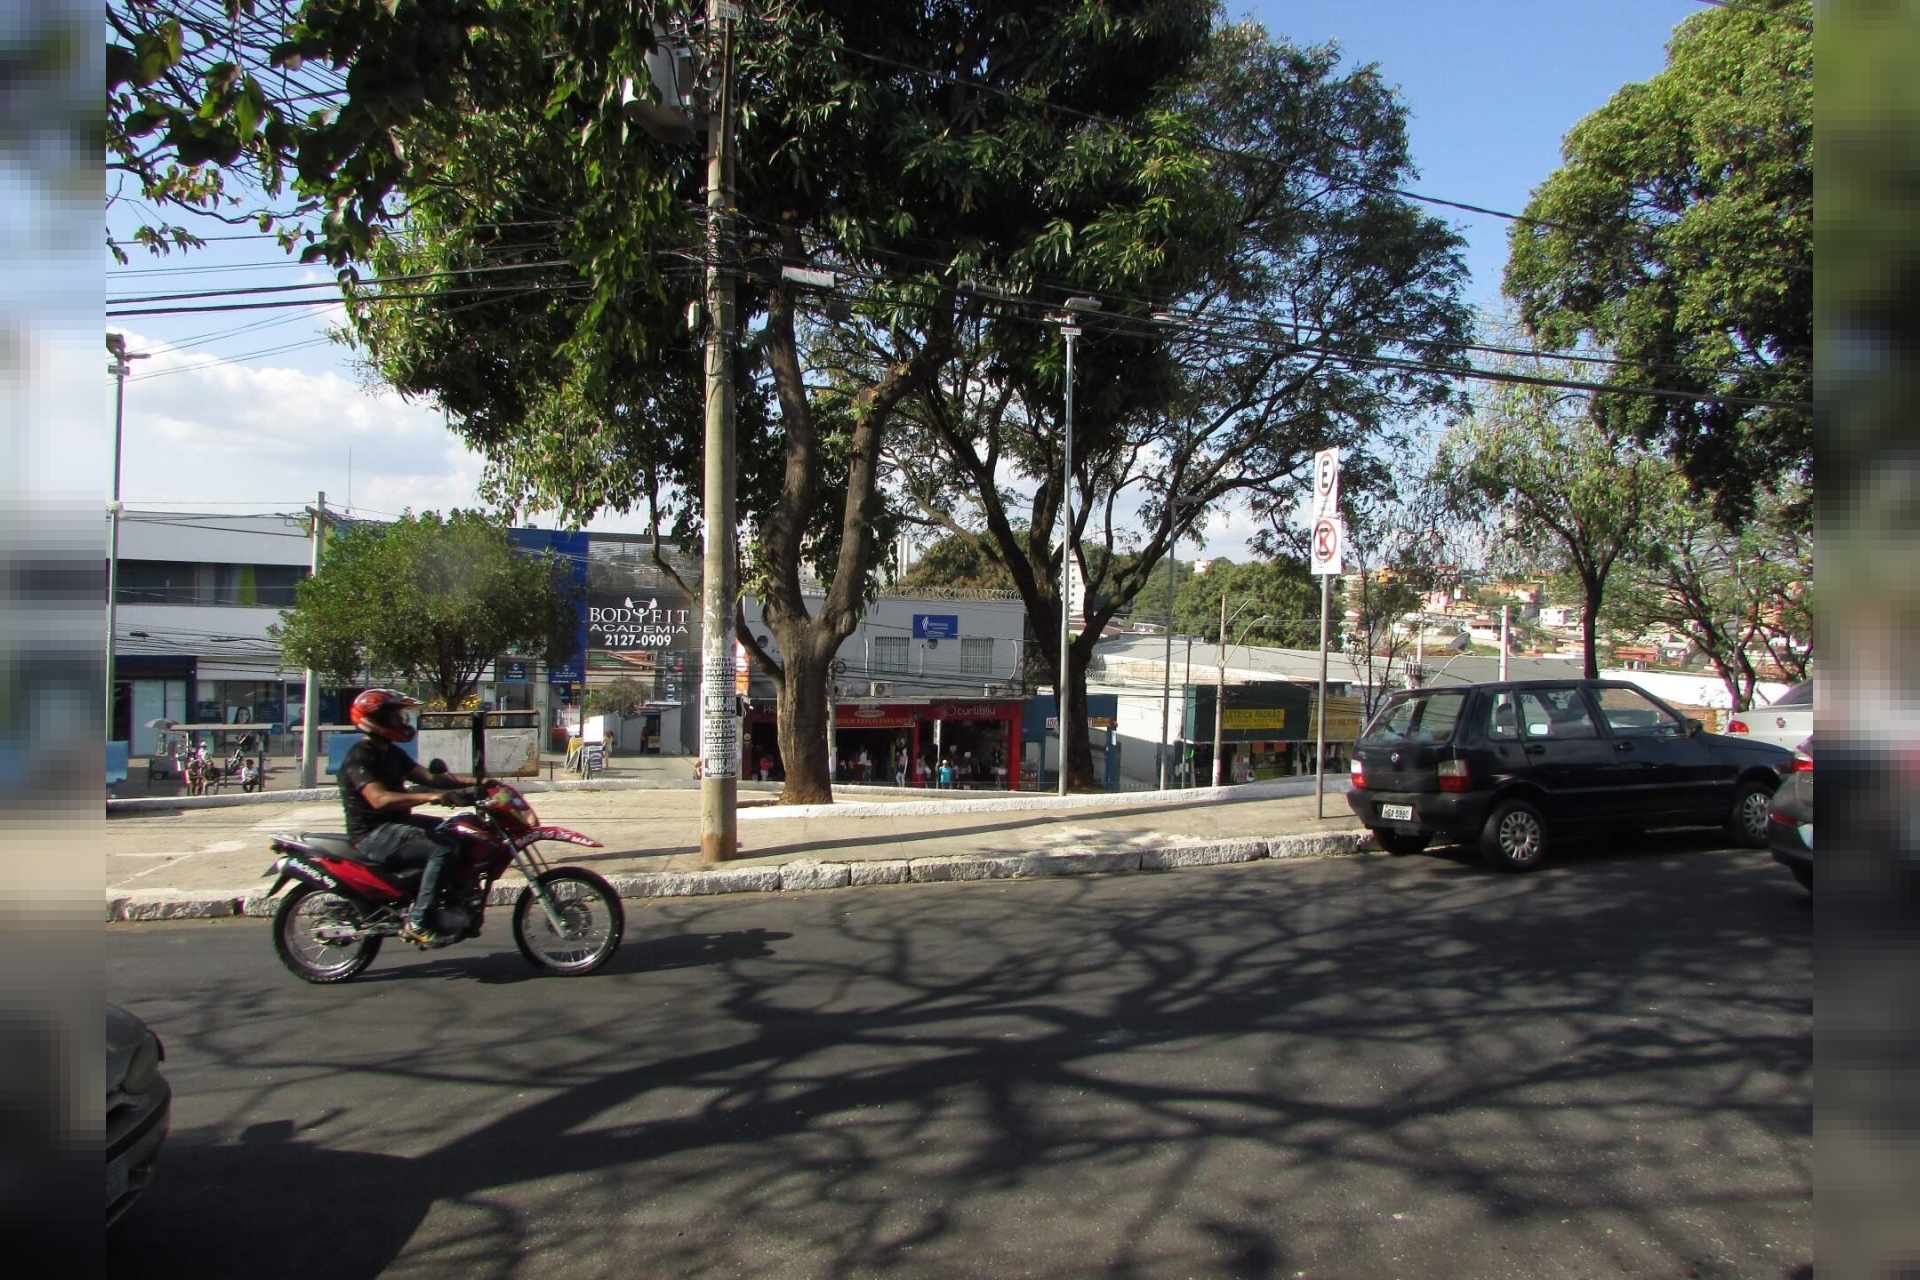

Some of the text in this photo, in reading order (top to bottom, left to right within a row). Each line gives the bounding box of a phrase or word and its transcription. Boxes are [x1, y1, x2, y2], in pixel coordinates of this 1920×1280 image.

[589, 623, 689, 634] ACADEMIA
[604, 634, 671, 647] 2127-0909
[1223, 710, 1252, 719] LETRICA
